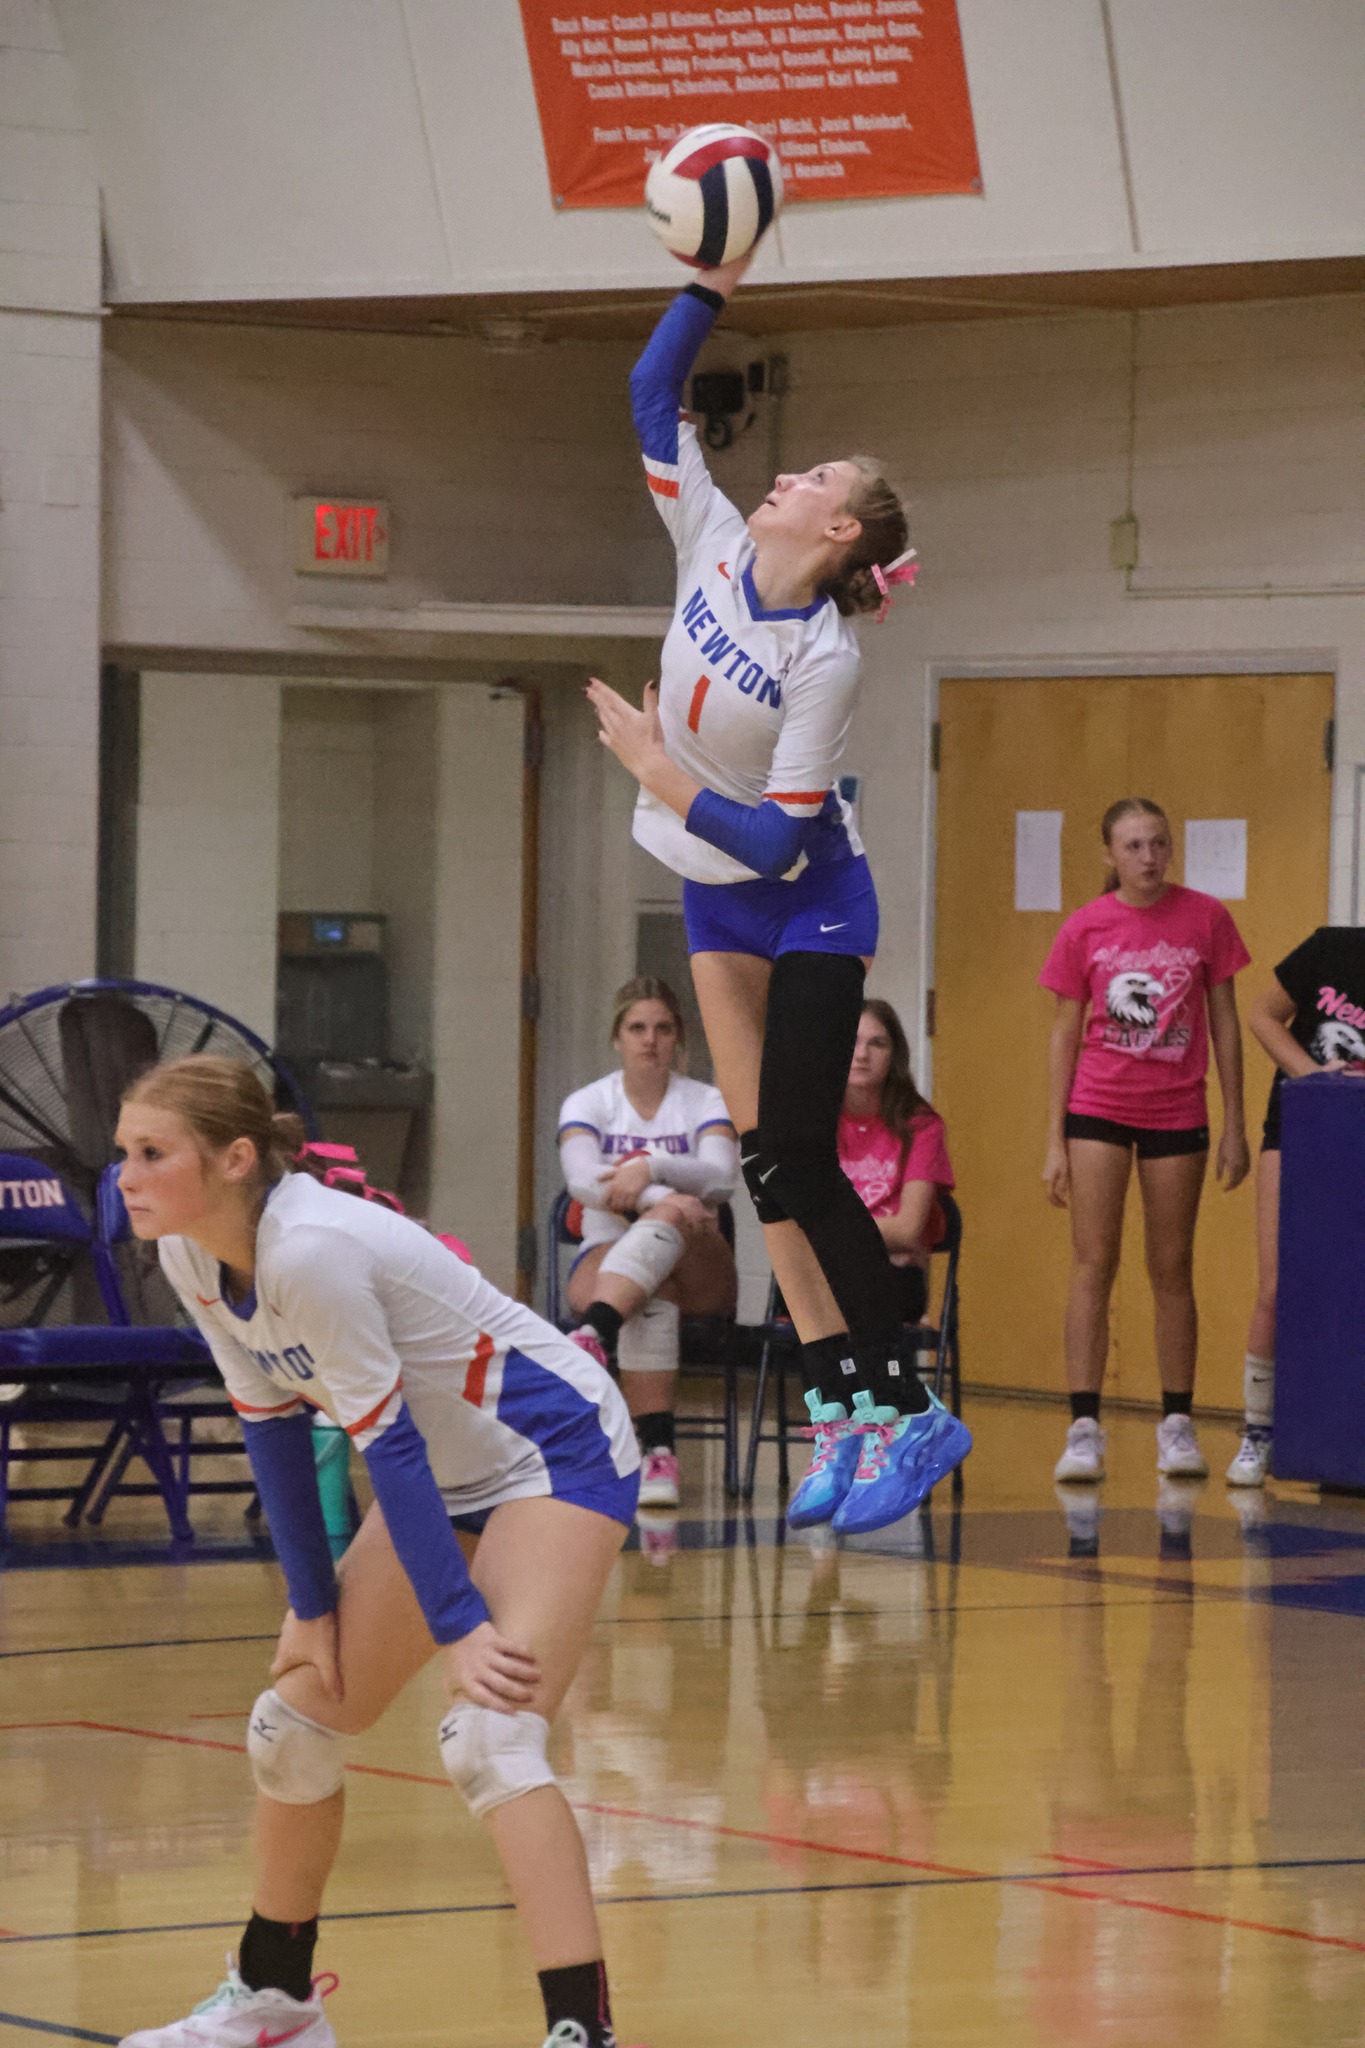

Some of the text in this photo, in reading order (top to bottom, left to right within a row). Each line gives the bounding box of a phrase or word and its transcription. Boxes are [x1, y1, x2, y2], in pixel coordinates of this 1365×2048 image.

[315, 504, 379, 561] EXIT
[681, 585, 782, 710] NEWTON
[687, 674, 711, 735] 1
[0, 1179, 66, 1210] TON
